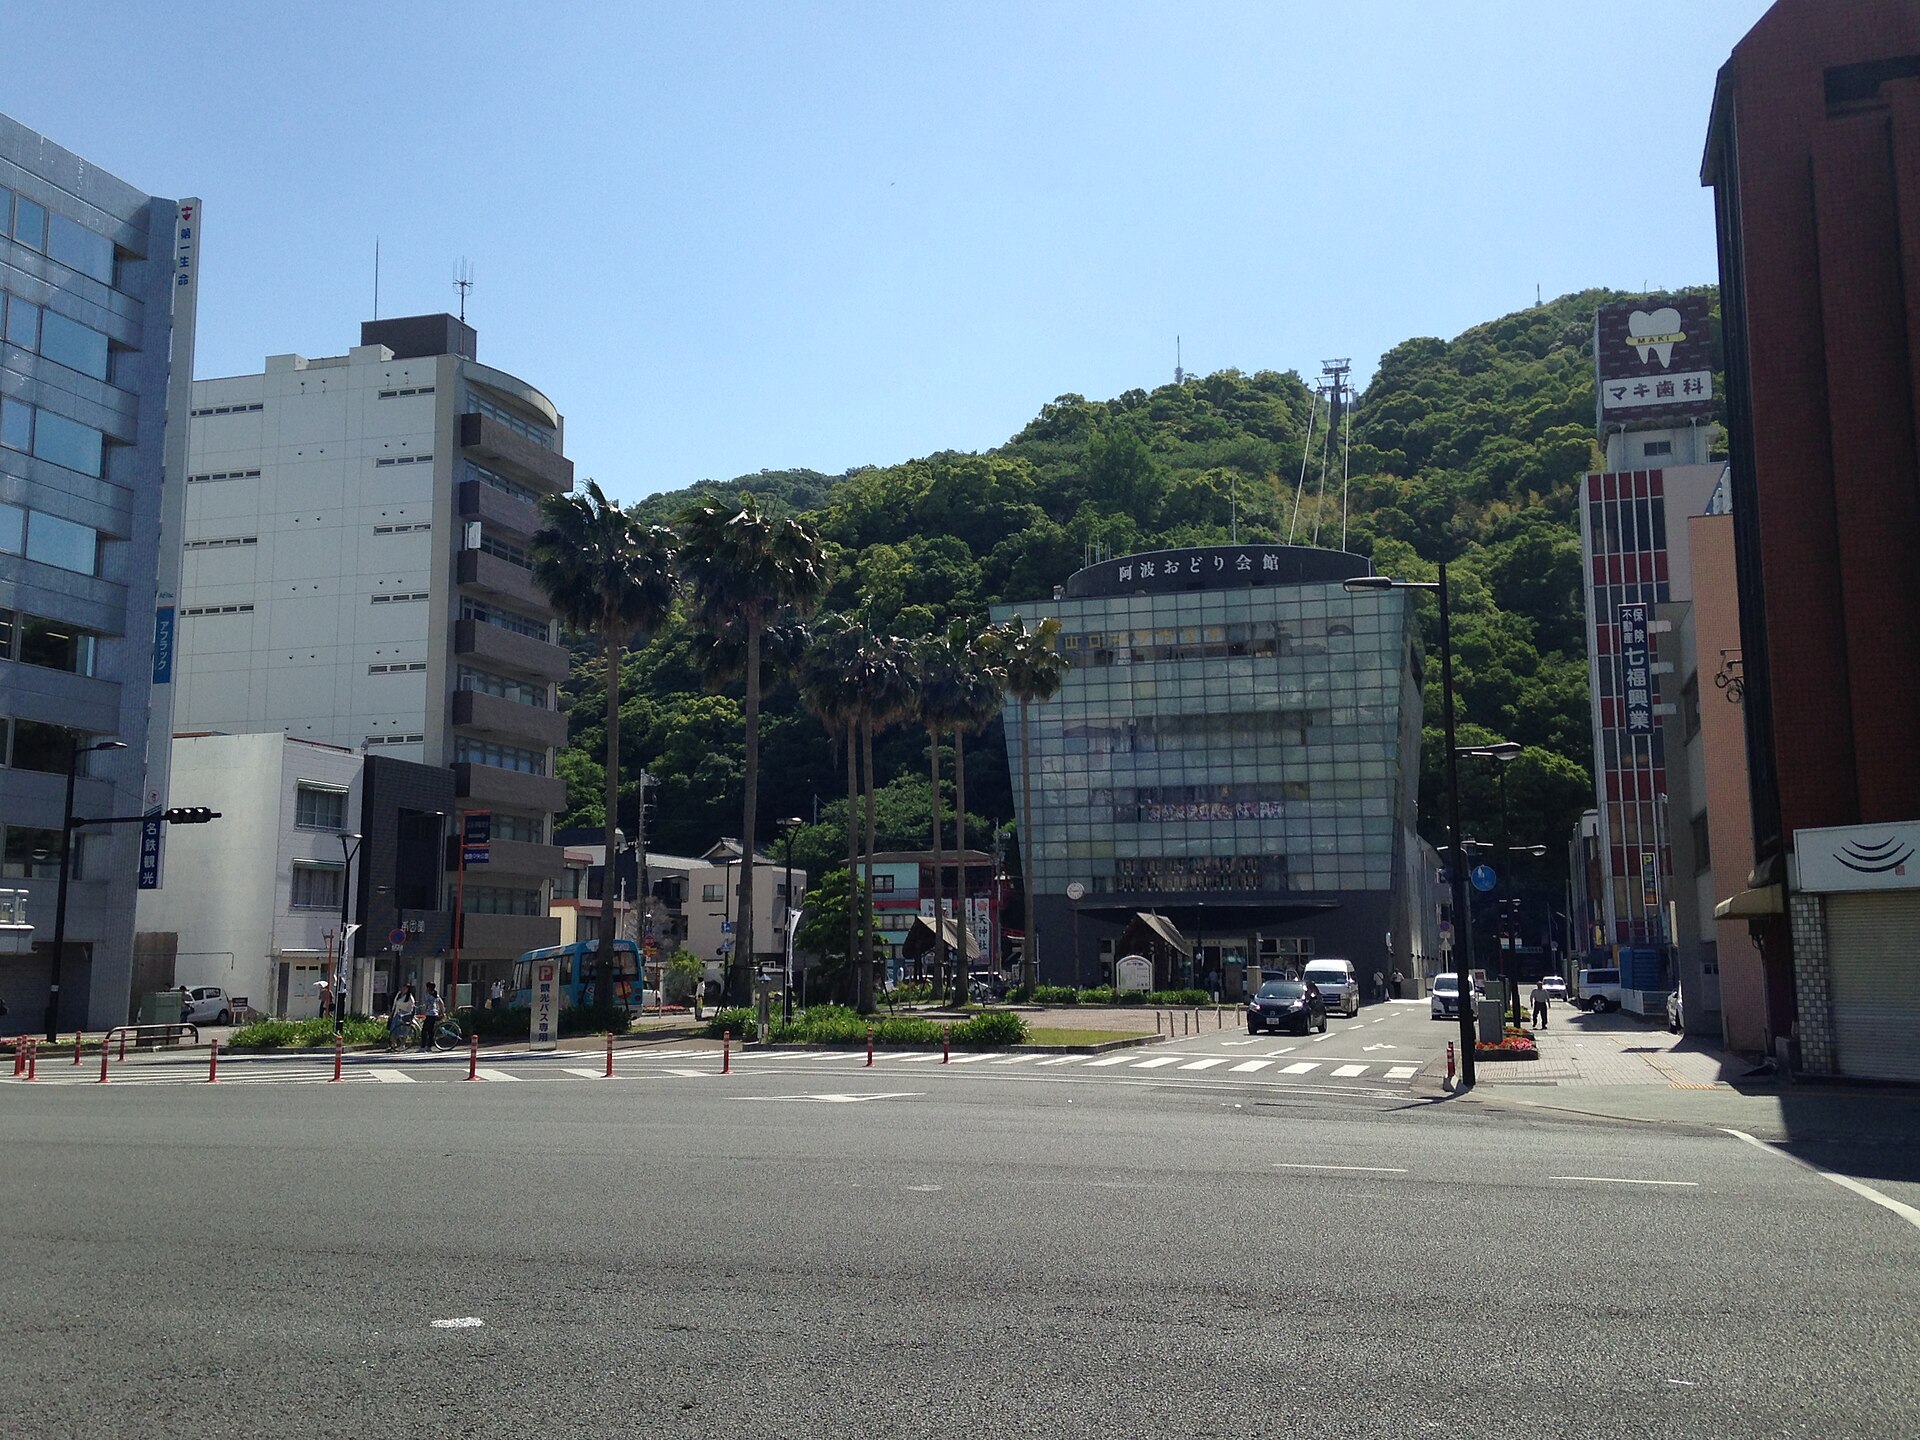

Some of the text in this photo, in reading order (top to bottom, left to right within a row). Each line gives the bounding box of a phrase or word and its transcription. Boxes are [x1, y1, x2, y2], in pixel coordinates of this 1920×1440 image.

[178, 227, 191, 286] 第一生命
[1637, 335, 1670, 344] MAKI
[1609, 377, 1704, 401] マキ歯科
[1119, 553, 1280, 583] 阿波おどり会館
[158, 620, 170, 671] アフラック
[1622, 609, 1634, 644] 不動産
[1633, 608, 1646, 644] 保険
[1624, 646, 1650, 730] 七福興業
[142, 822, 157, 885] 名鉄観光
[538, 983, 550, 1042] 観光バス専用
